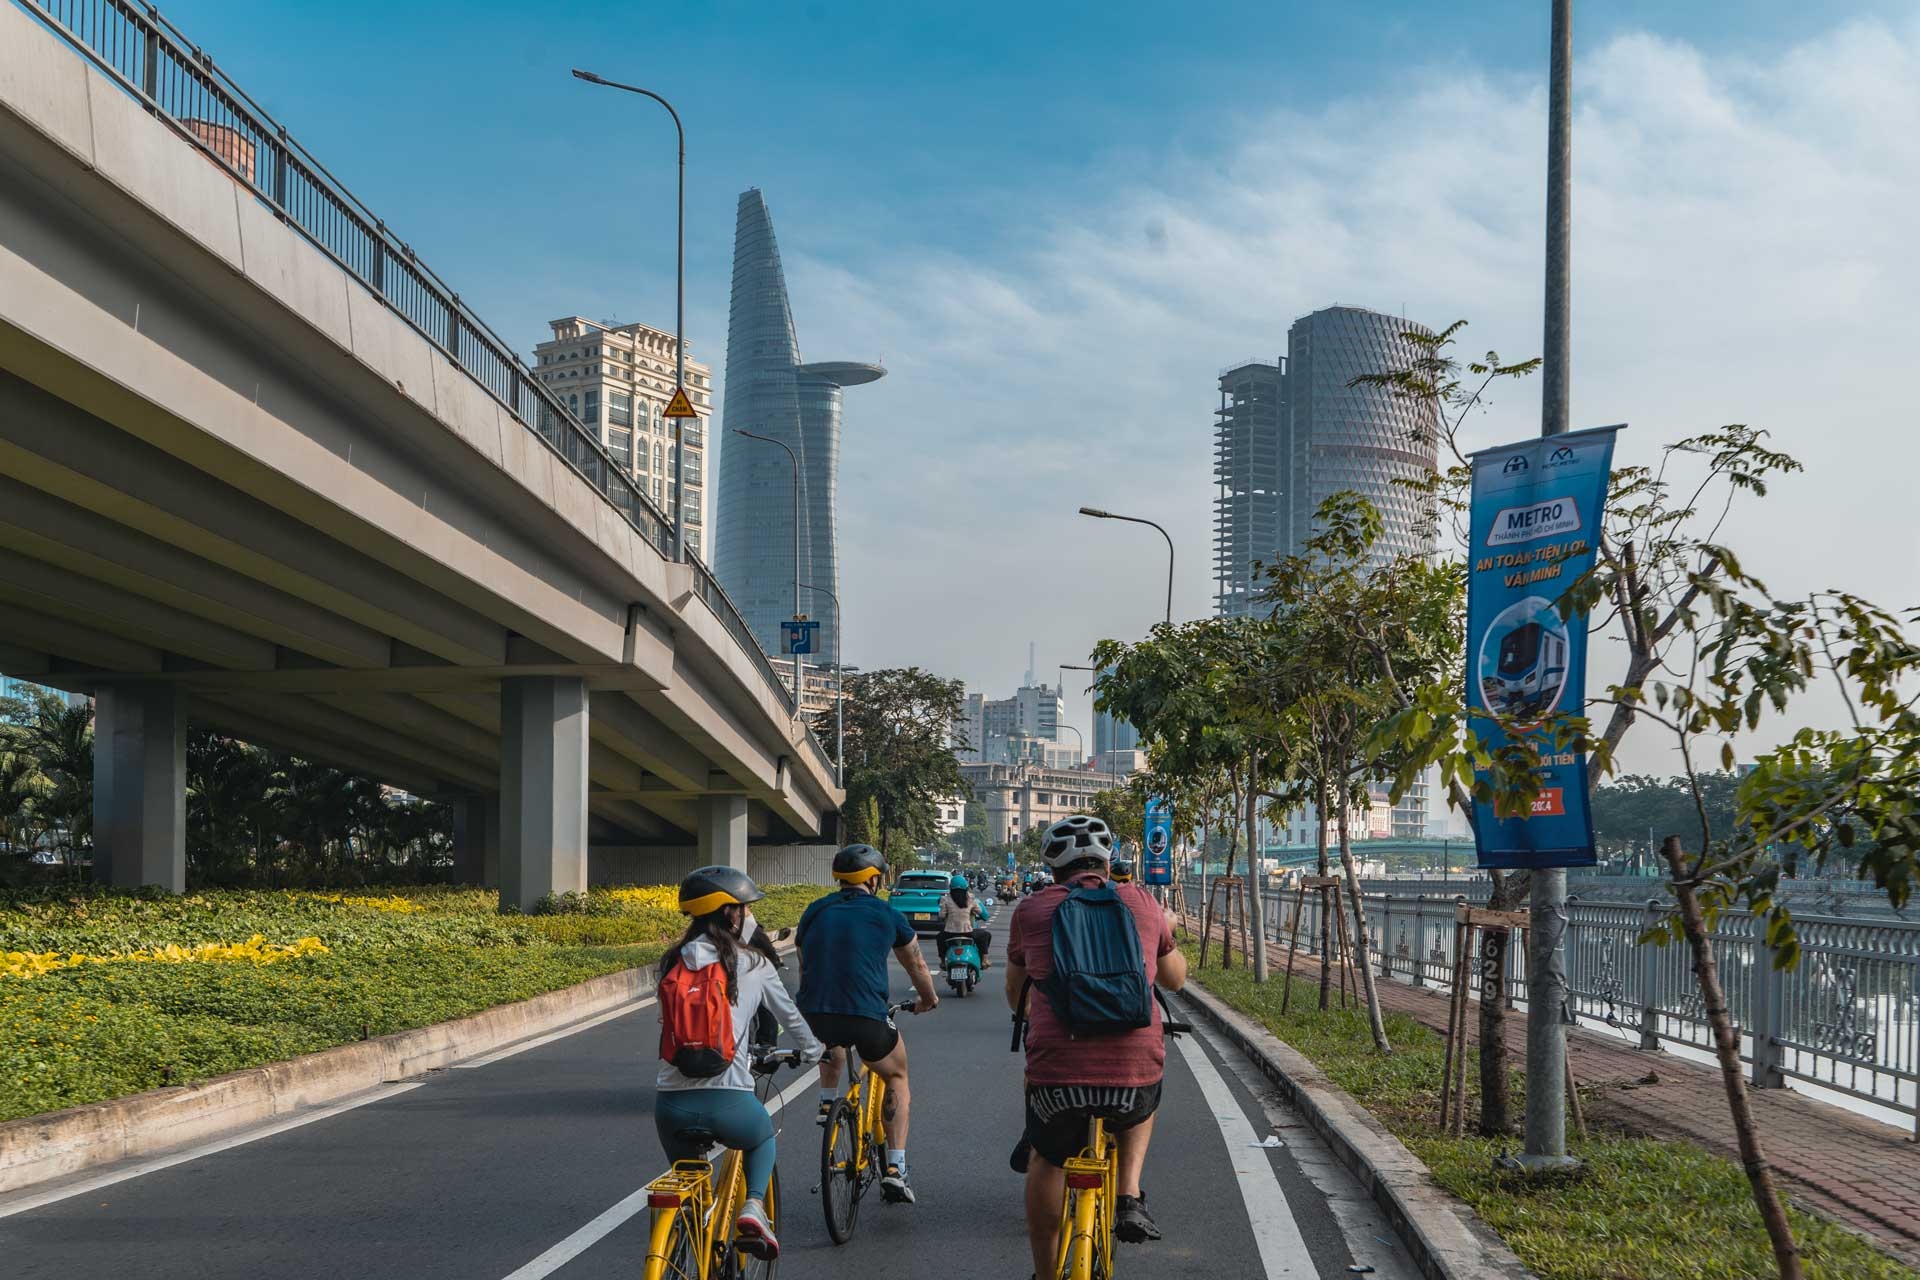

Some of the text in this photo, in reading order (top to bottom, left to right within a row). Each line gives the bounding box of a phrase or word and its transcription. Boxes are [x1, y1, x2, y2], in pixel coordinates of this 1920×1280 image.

[1507, 503, 1563, 530] METRO
[1476, 558, 1493, 571] AN
[1530, 564, 1561, 583] MINH
